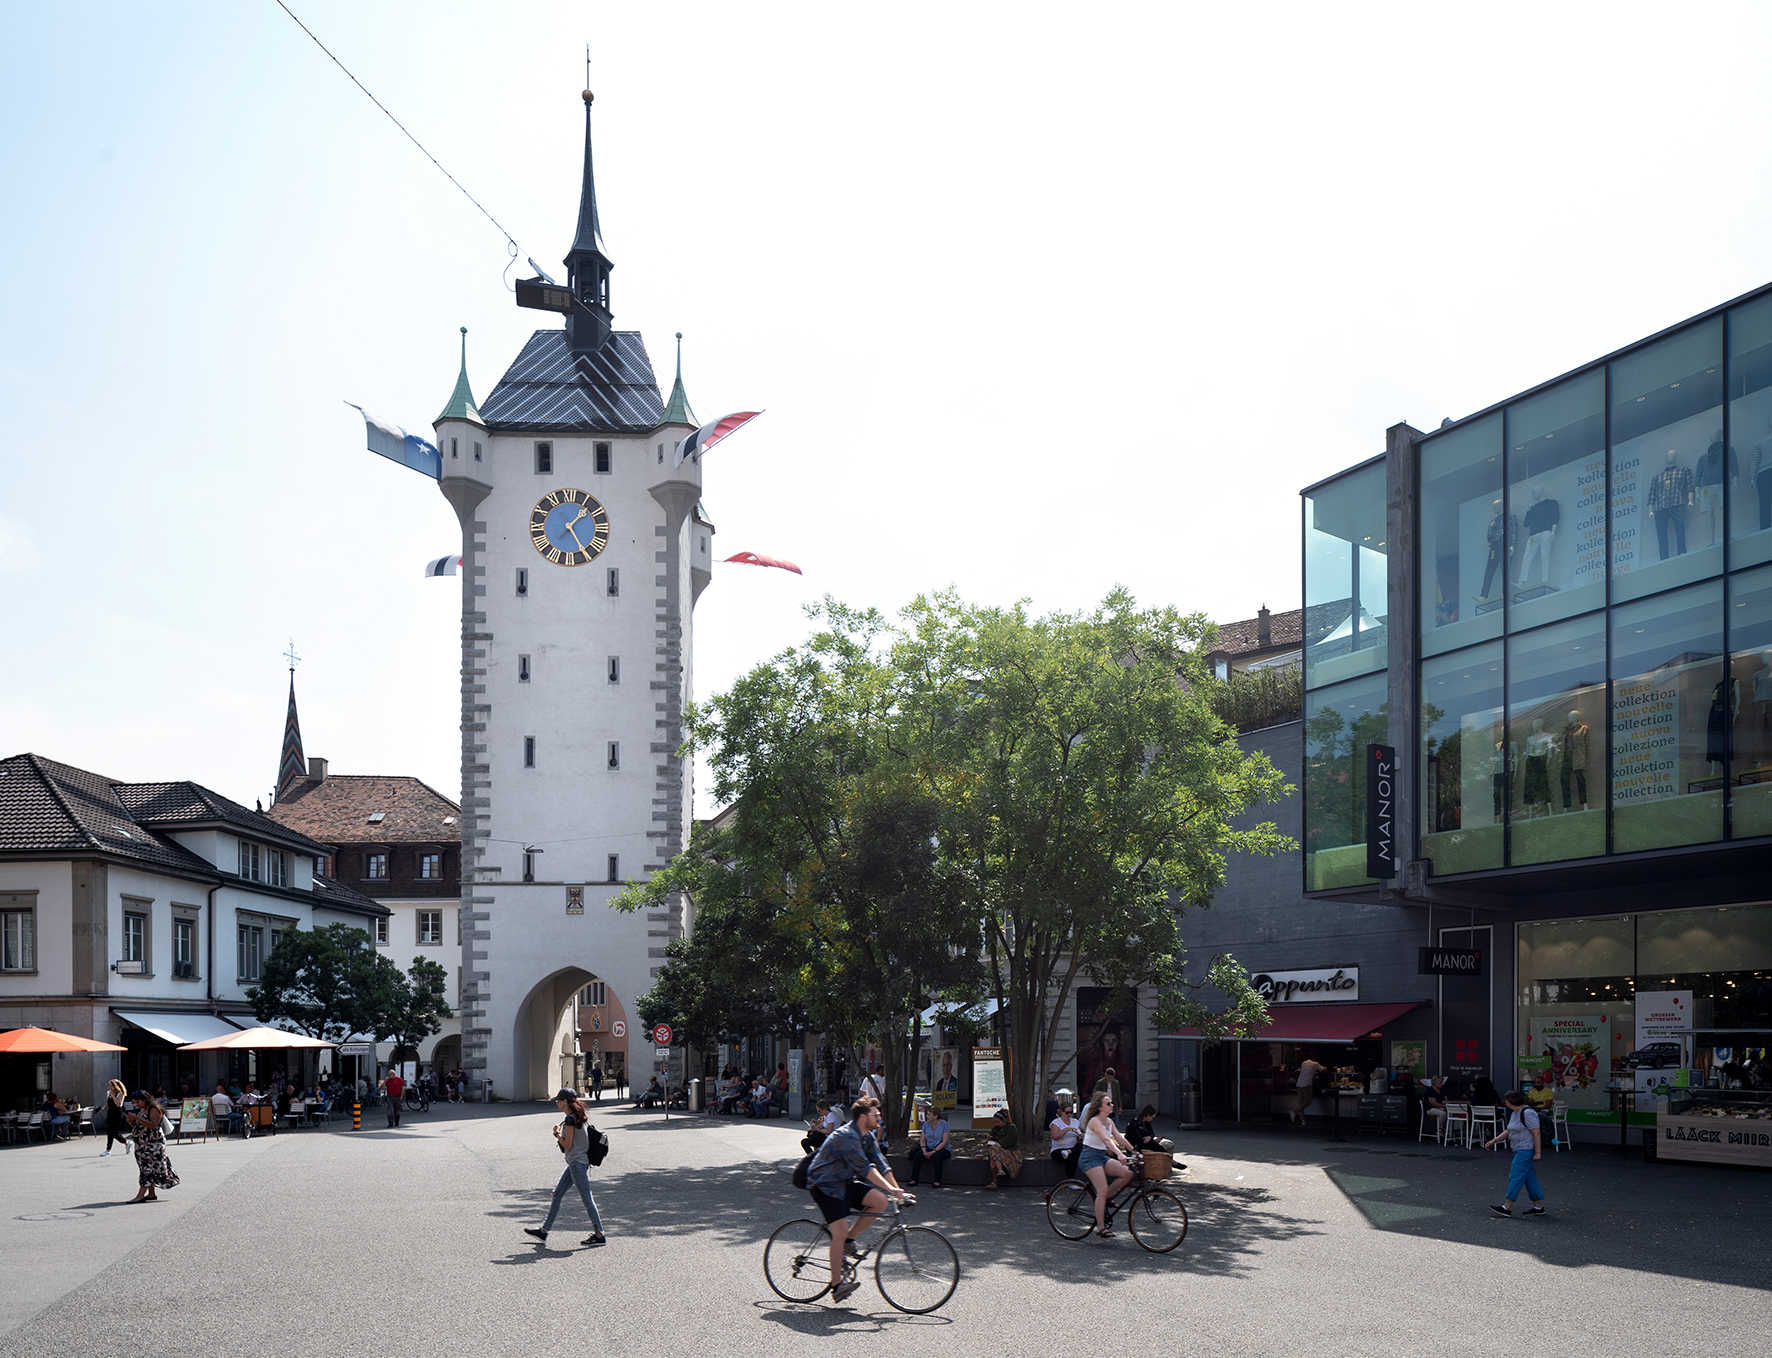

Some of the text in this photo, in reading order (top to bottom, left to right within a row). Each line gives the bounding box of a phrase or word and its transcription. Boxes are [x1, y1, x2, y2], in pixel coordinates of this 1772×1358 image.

[1582, 470, 1636, 496] nouelle
[1577, 481, 1636, 509] colletion
[1595, 494, 1634, 514] nova
[1577, 504, 1638, 531] colleione
[1576, 527, 1636, 553] kolletion
[1584, 523, 1614, 540] neu
[1575, 551, 1634, 576] collecion
[1612, 689, 1676, 710] kollektion
[1619, 683, 1651, 697] neue
[1617, 701, 1673, 720] nouvelle
[1612, 713, 1673, 733] collection
[1631, 726, 1671, 740] nuova
[1612, 736, 1675, 755] collezione
[1620, 752, 1651, 765] neue
[1612, 760, 1674, 778] kollektion
[1614, 772, 1670, 789] nouvelle
[1612, 784, 1673, 801] collection
[1378, 762, 1391, 861] MANOR
[1432, 953, 1475, 970] MANOR
[1257, 969, 1355, 1001] appunto
[935, 1093, 955, 1101] ROLAND
[1666, 1126, 1772, 1147] LÄÄCK MIIR
